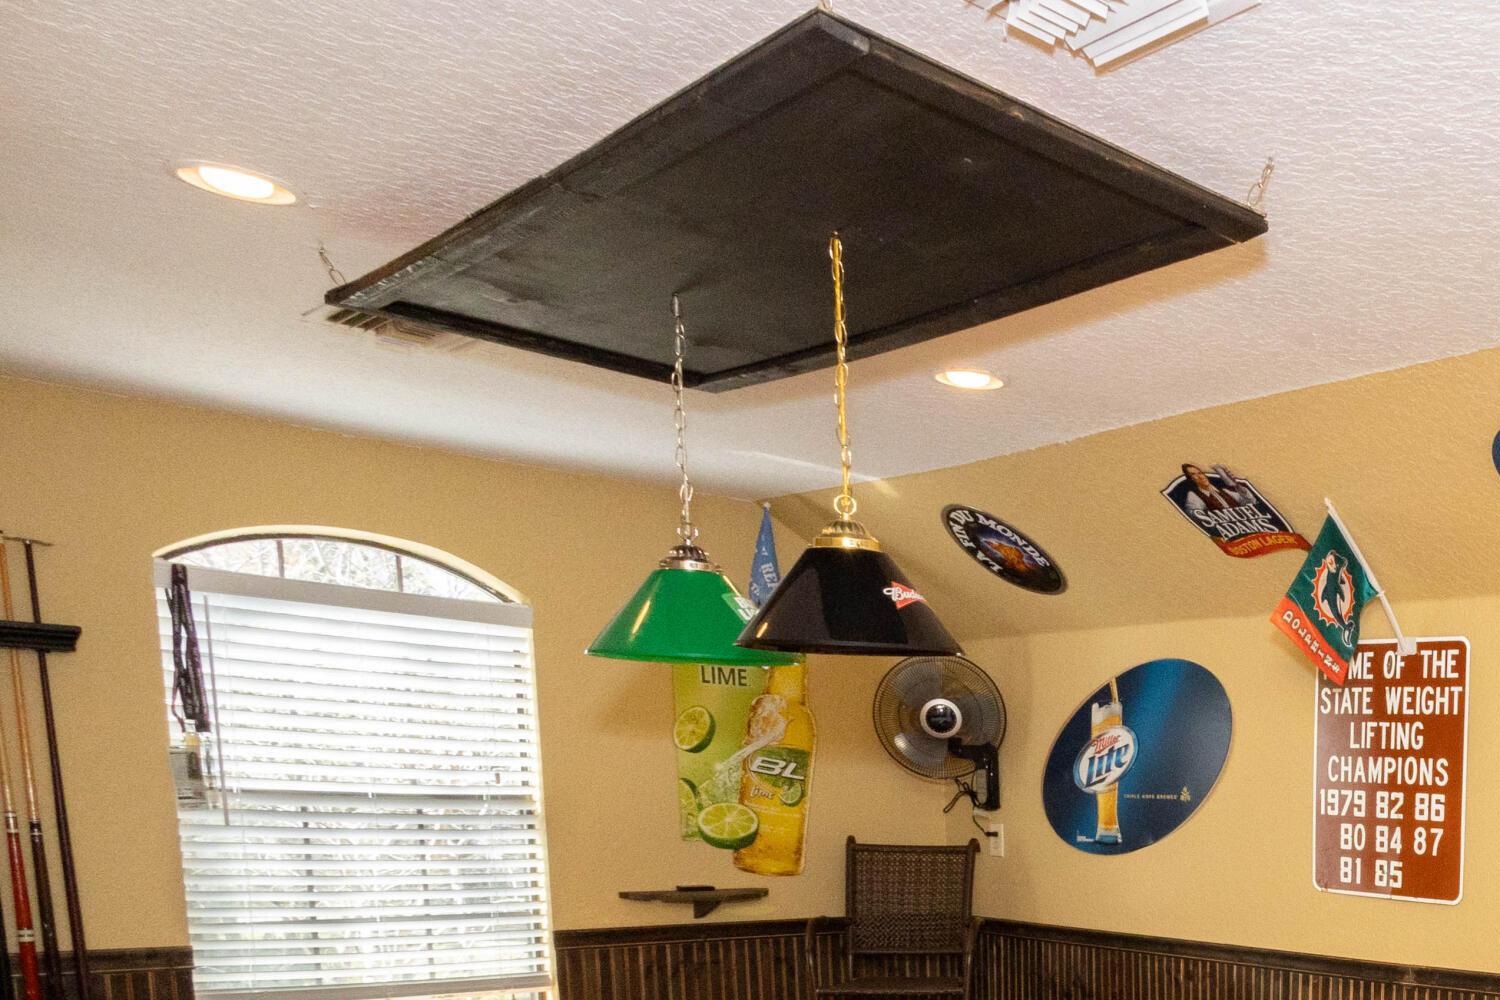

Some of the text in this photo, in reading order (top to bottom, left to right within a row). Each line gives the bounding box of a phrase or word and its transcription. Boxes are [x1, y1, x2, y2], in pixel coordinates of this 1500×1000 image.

[1194, 503, 1272, 527] SAMUEL
[1215, 517, 1279, 541] ADAMS
[949, 510, 1050, 572] LA FIN DU MONDE
[1283, 610, 1340, 674] DOLPHINS
[701, 666, 747, 686] LIME
[1383, 650, 1405, 679] OF
[1420, 649, 1459, 679] THE
[1320, 686, 1462, 715] STATE WEIGHT
[1091, 735, 1120, 754] Miller
[1350, 721, 1424, 750] LIFTING
[1084, 744, 1129, 788] Lite
[1327, 755, 1448, 786] CHAMPIONS
[1320, 788, 1445, 822] 1979 82 86
[1340, 823, 1444, 856] 80 84 87
[1340, 857, 1403, 888] 81 85
